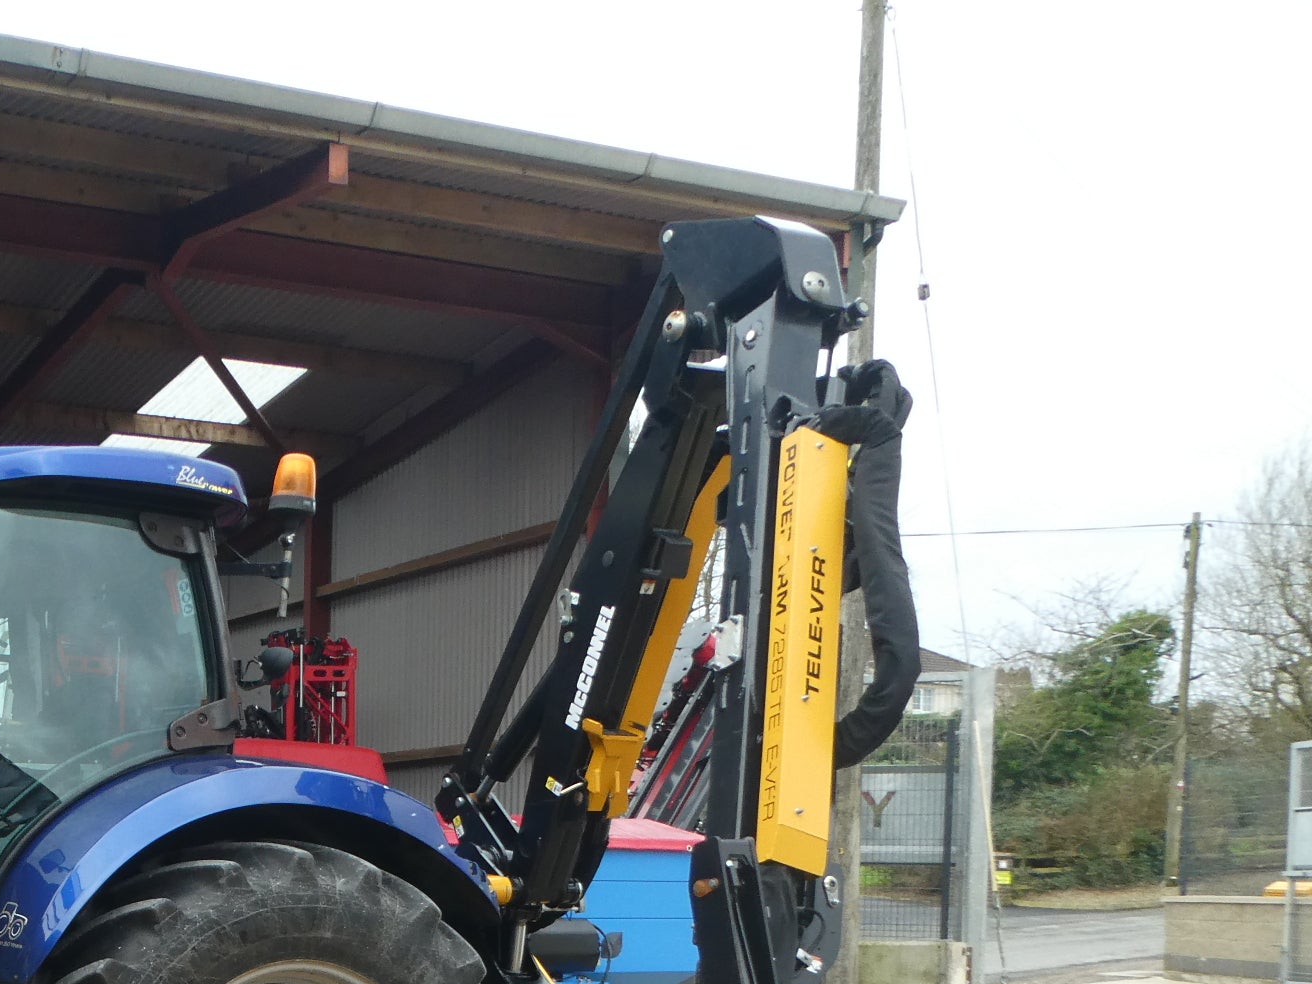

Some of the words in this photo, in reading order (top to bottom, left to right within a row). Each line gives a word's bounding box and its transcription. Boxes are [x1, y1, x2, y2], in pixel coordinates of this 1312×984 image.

[176, 465, 205, 485] Blue
[770, 623, 787, 694] 7285
[805, 555, 826, 696] TELE-VFR
